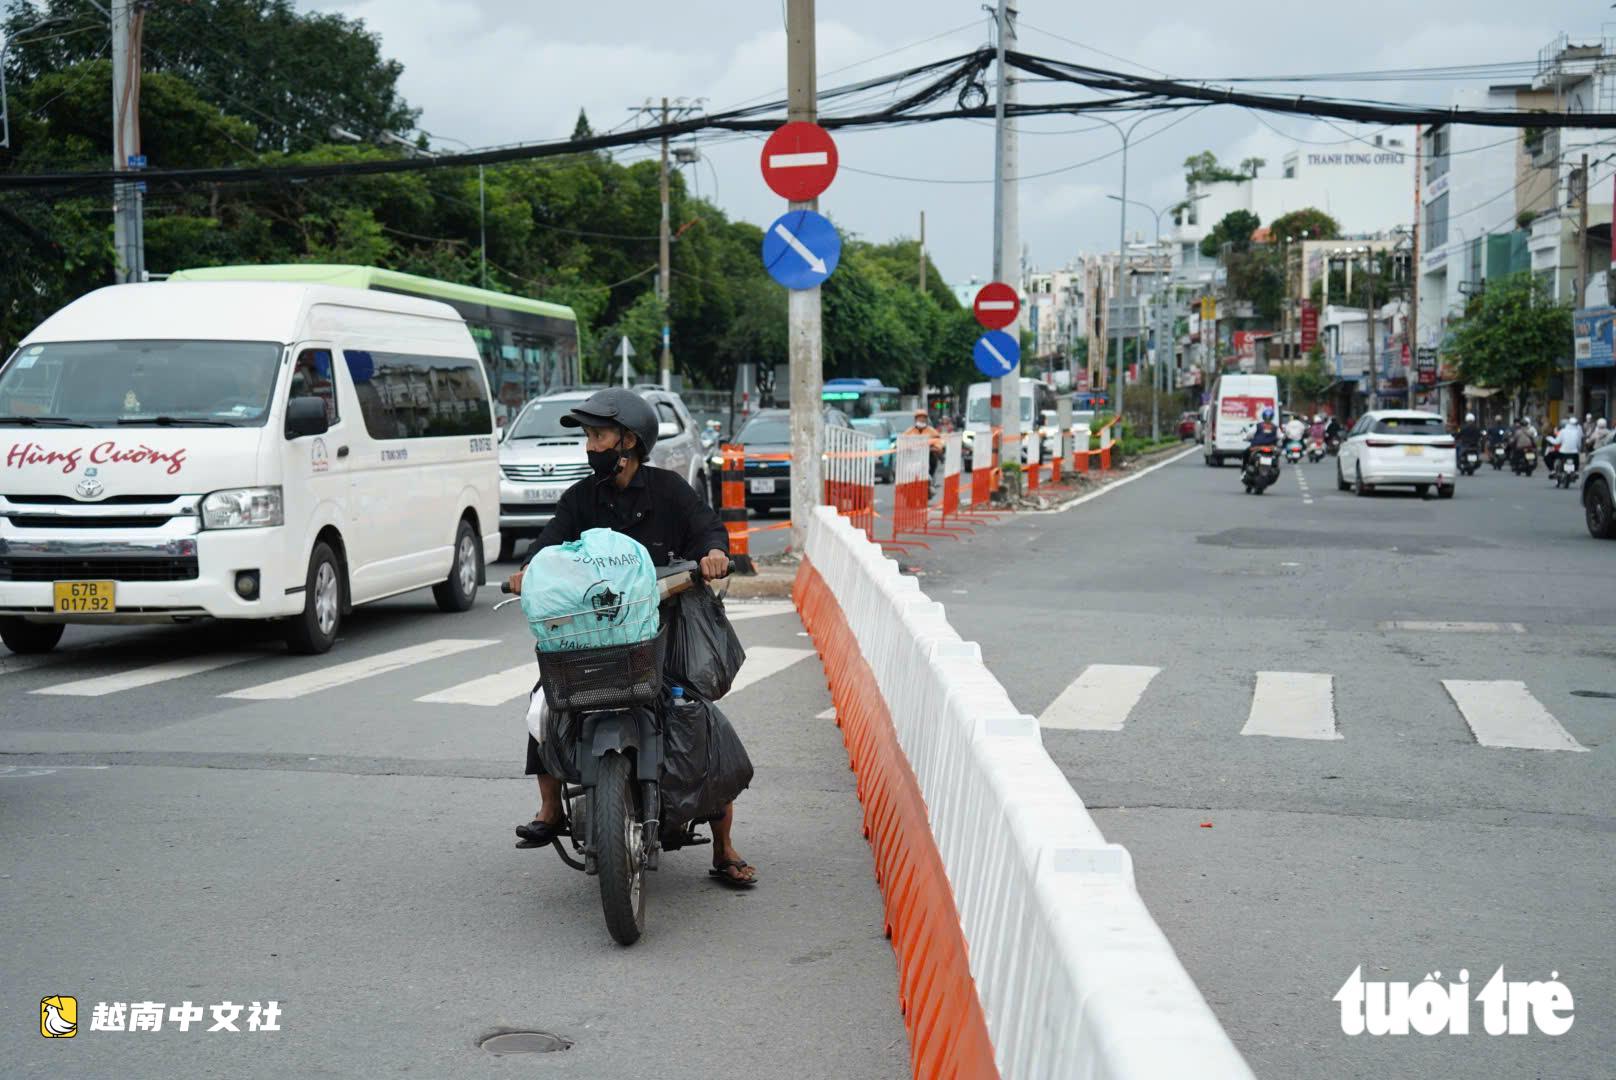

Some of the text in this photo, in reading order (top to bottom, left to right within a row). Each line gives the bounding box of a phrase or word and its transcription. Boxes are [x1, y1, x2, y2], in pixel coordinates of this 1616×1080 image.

[1308, 154, 1343, 166] THANH
[7, 441, 187, 475] Hùng Cường
[71, 583, 98, 597] 67B
[61, 597, 109, 611] 017.92
